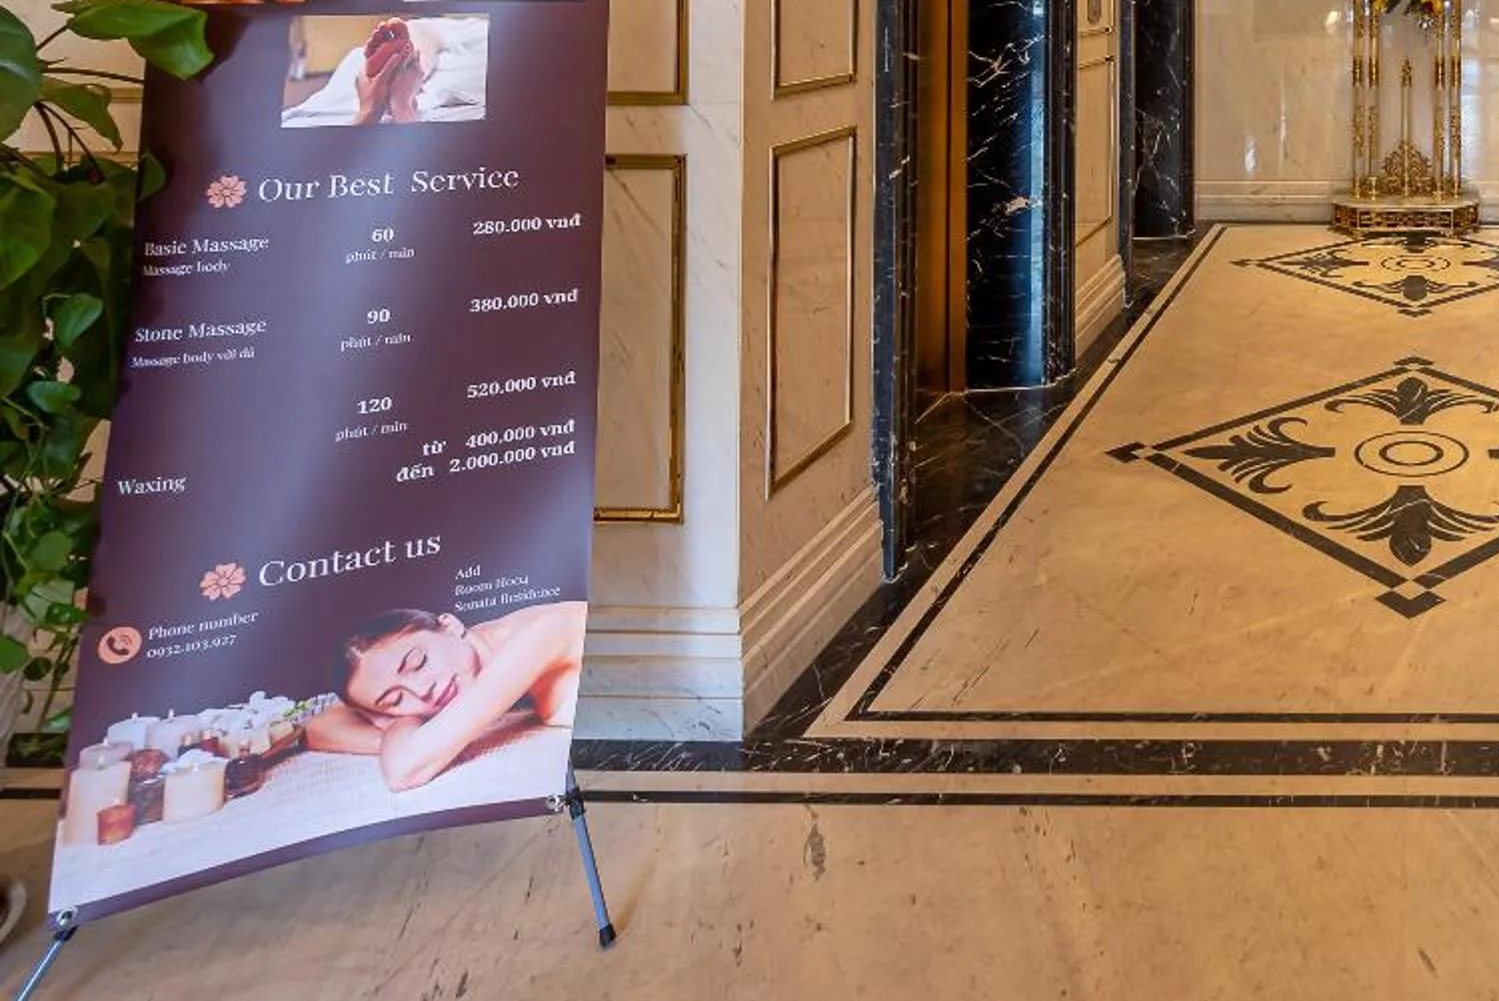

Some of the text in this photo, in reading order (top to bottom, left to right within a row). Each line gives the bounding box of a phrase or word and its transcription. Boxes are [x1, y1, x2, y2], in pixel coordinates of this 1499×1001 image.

[258, 166, 519, 202] Our Best Service
[371, 227, 395, 242] 60
[472, 217, 542, 236] 280.000
[144, 236, 270, 257] Basic Massage
[196, 259, 231, 273] body
[469, 293, 539, 312] 380.000
[366, 308, 391, 325] 90
[134, 320, 268, 343] Stone Massage
[467, 376, 536, 398] 520.000
[356, 397, 393, 414] 120
[464, 425, 536, 448] 400.000
[449, 446, 536, 473] 2.000.000
[117, 476, 187, 494] Waxing
[259, 534, 442, 587] Contact us
[455, 564, 481, 580] Add
[147, 612, 259, 640] Phone number
